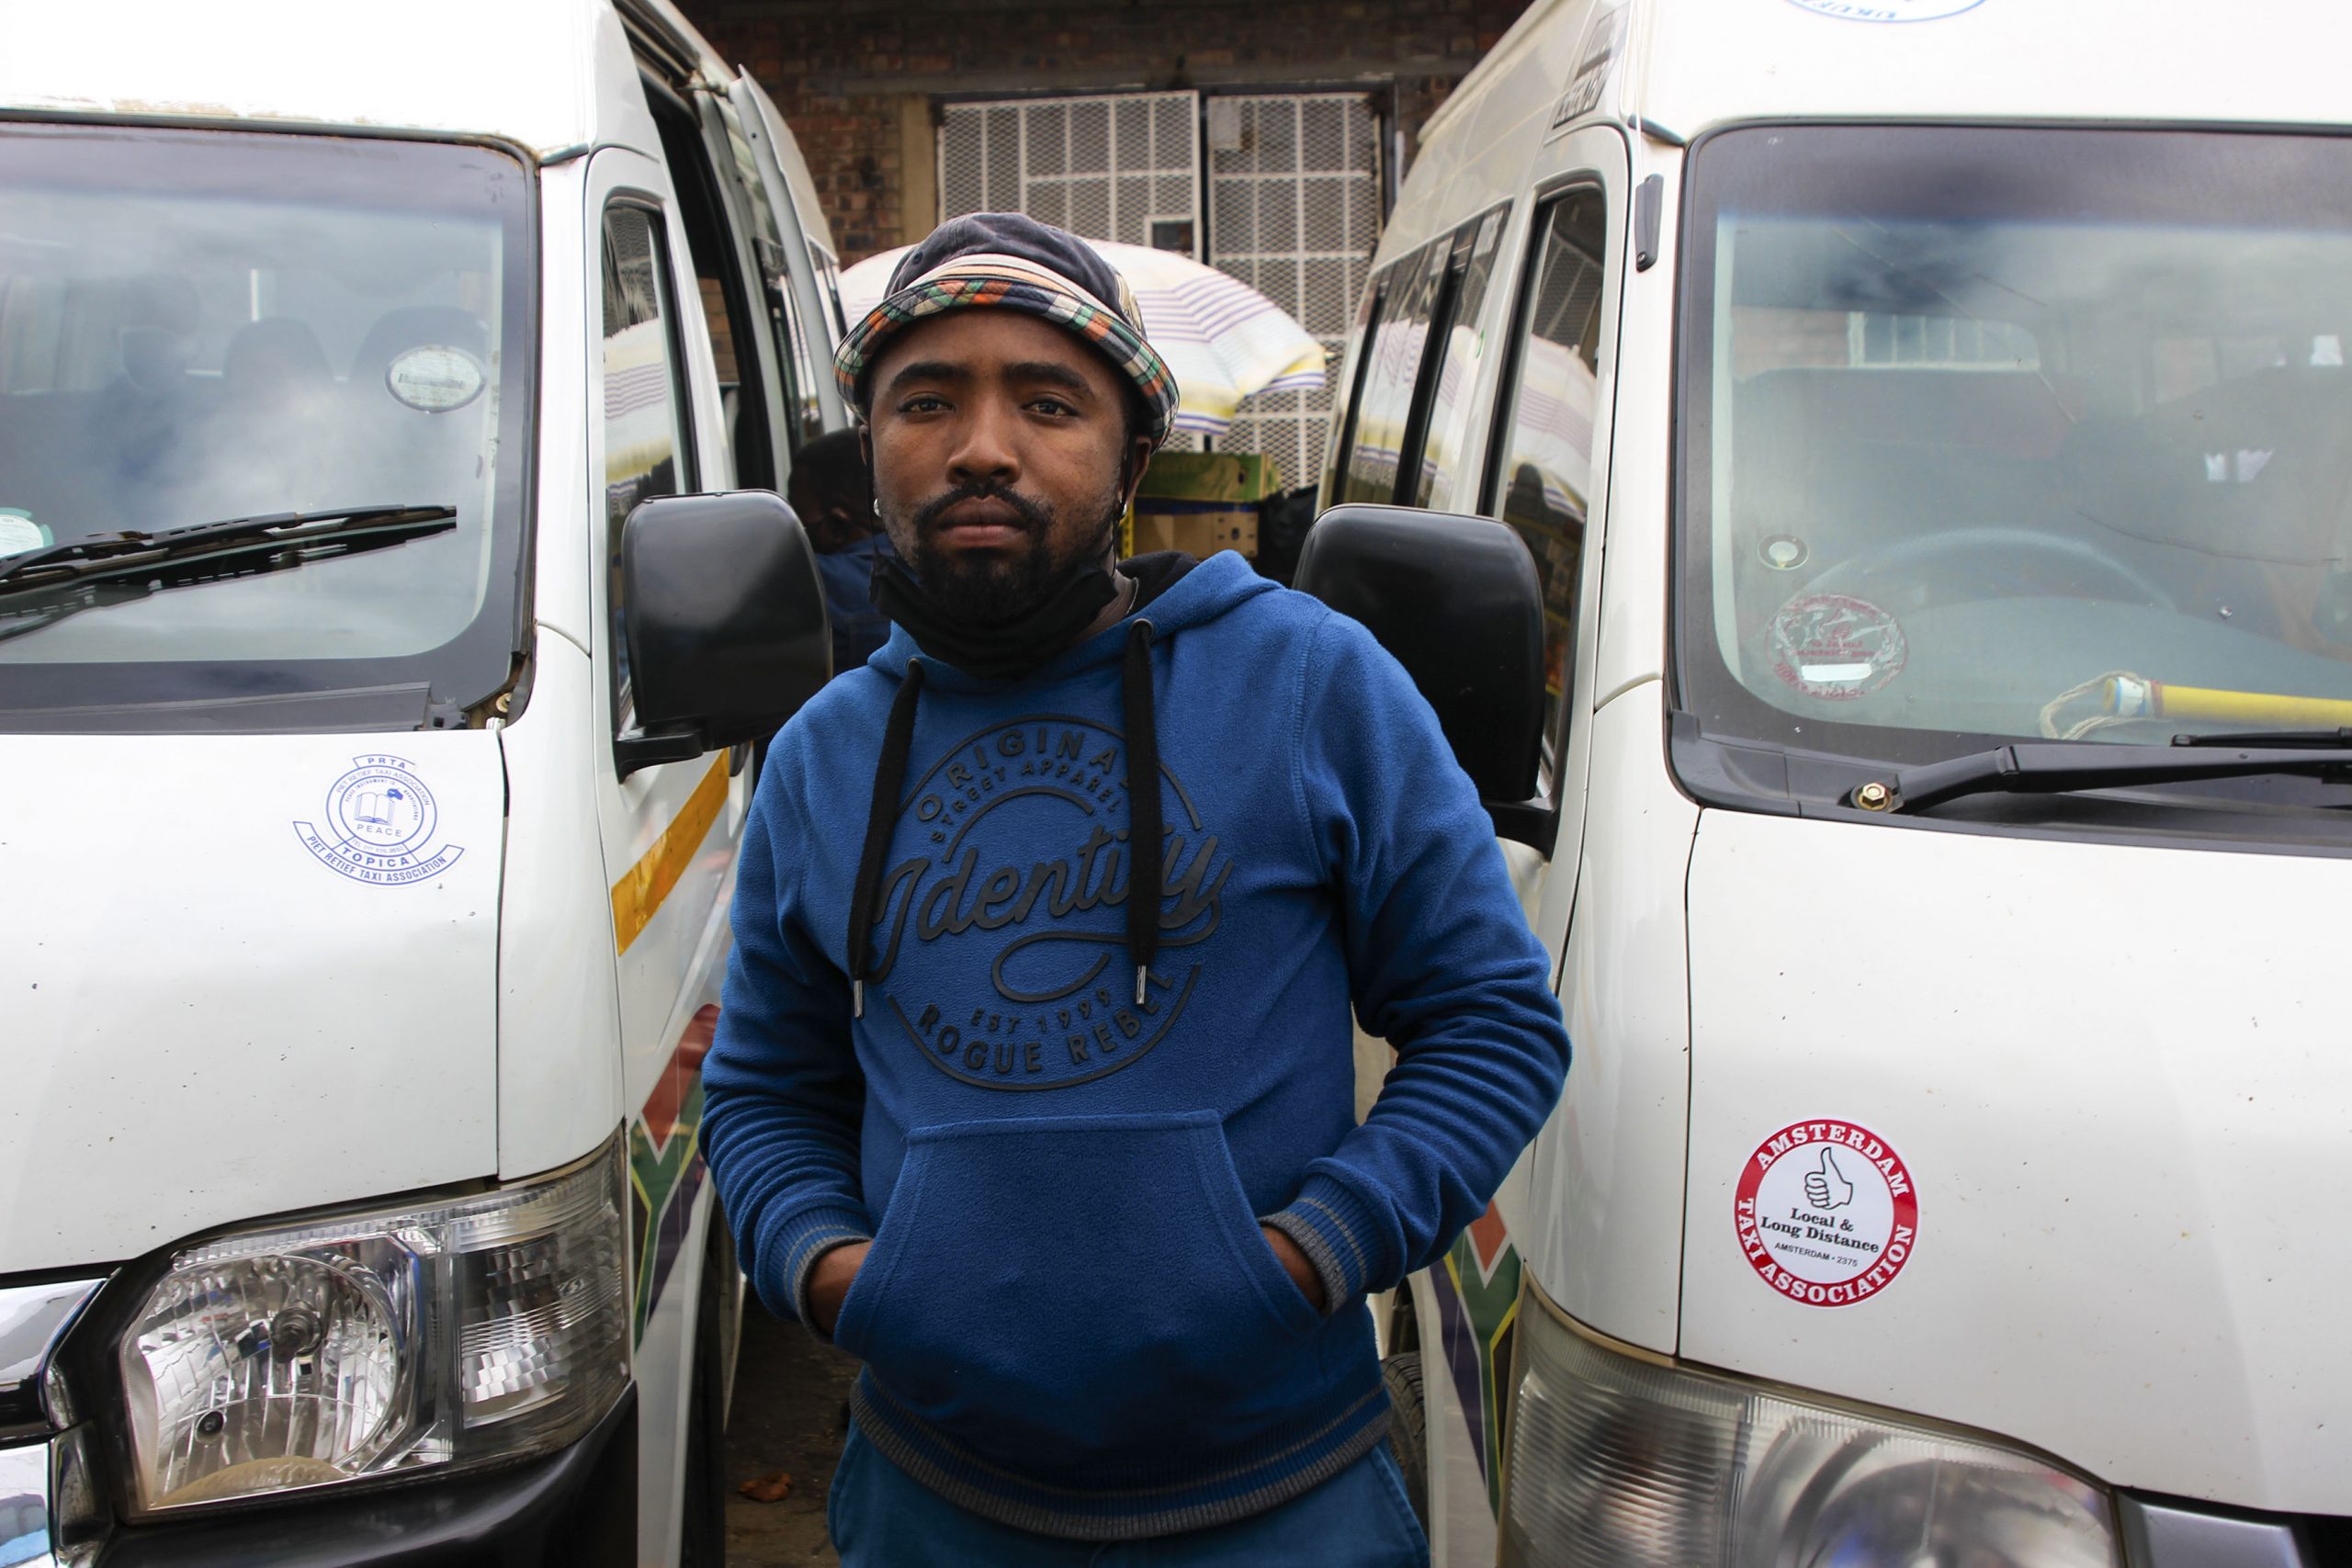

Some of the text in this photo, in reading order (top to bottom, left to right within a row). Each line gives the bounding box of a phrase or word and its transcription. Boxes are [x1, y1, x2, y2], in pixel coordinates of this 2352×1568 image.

[368, 757, 406, 769] PRTA
[918, 727, 1132, 821] ORIGINA
[393, 772, 431, 806] ASSOCIATION
[930, 759, 1125, 842] STREET APPAREL
[356, 824, 402, 837] PEACE
[307, 835, 447, 883] PIET RETIEF TAXI ASSOCIATION
[340, 847, 410, 867] TOPICA
[866, 823, 1235, 1001] Identiy
[971, 987, 1111, 1032] EST 1999
[920, 1002, 1042, 1073] ROGUE
[1756, 1123, 1910, 1198] AMSTERDAM
[1760, 1216, 1880, 1253] Long Distance
[1790, 1208, 1854, 1232] Local &
[1737, 1197, 1913, 1303] TAXI ASSOCIATION
[1774, 1242, 1859, 1268] AMSTERDAM 2375
